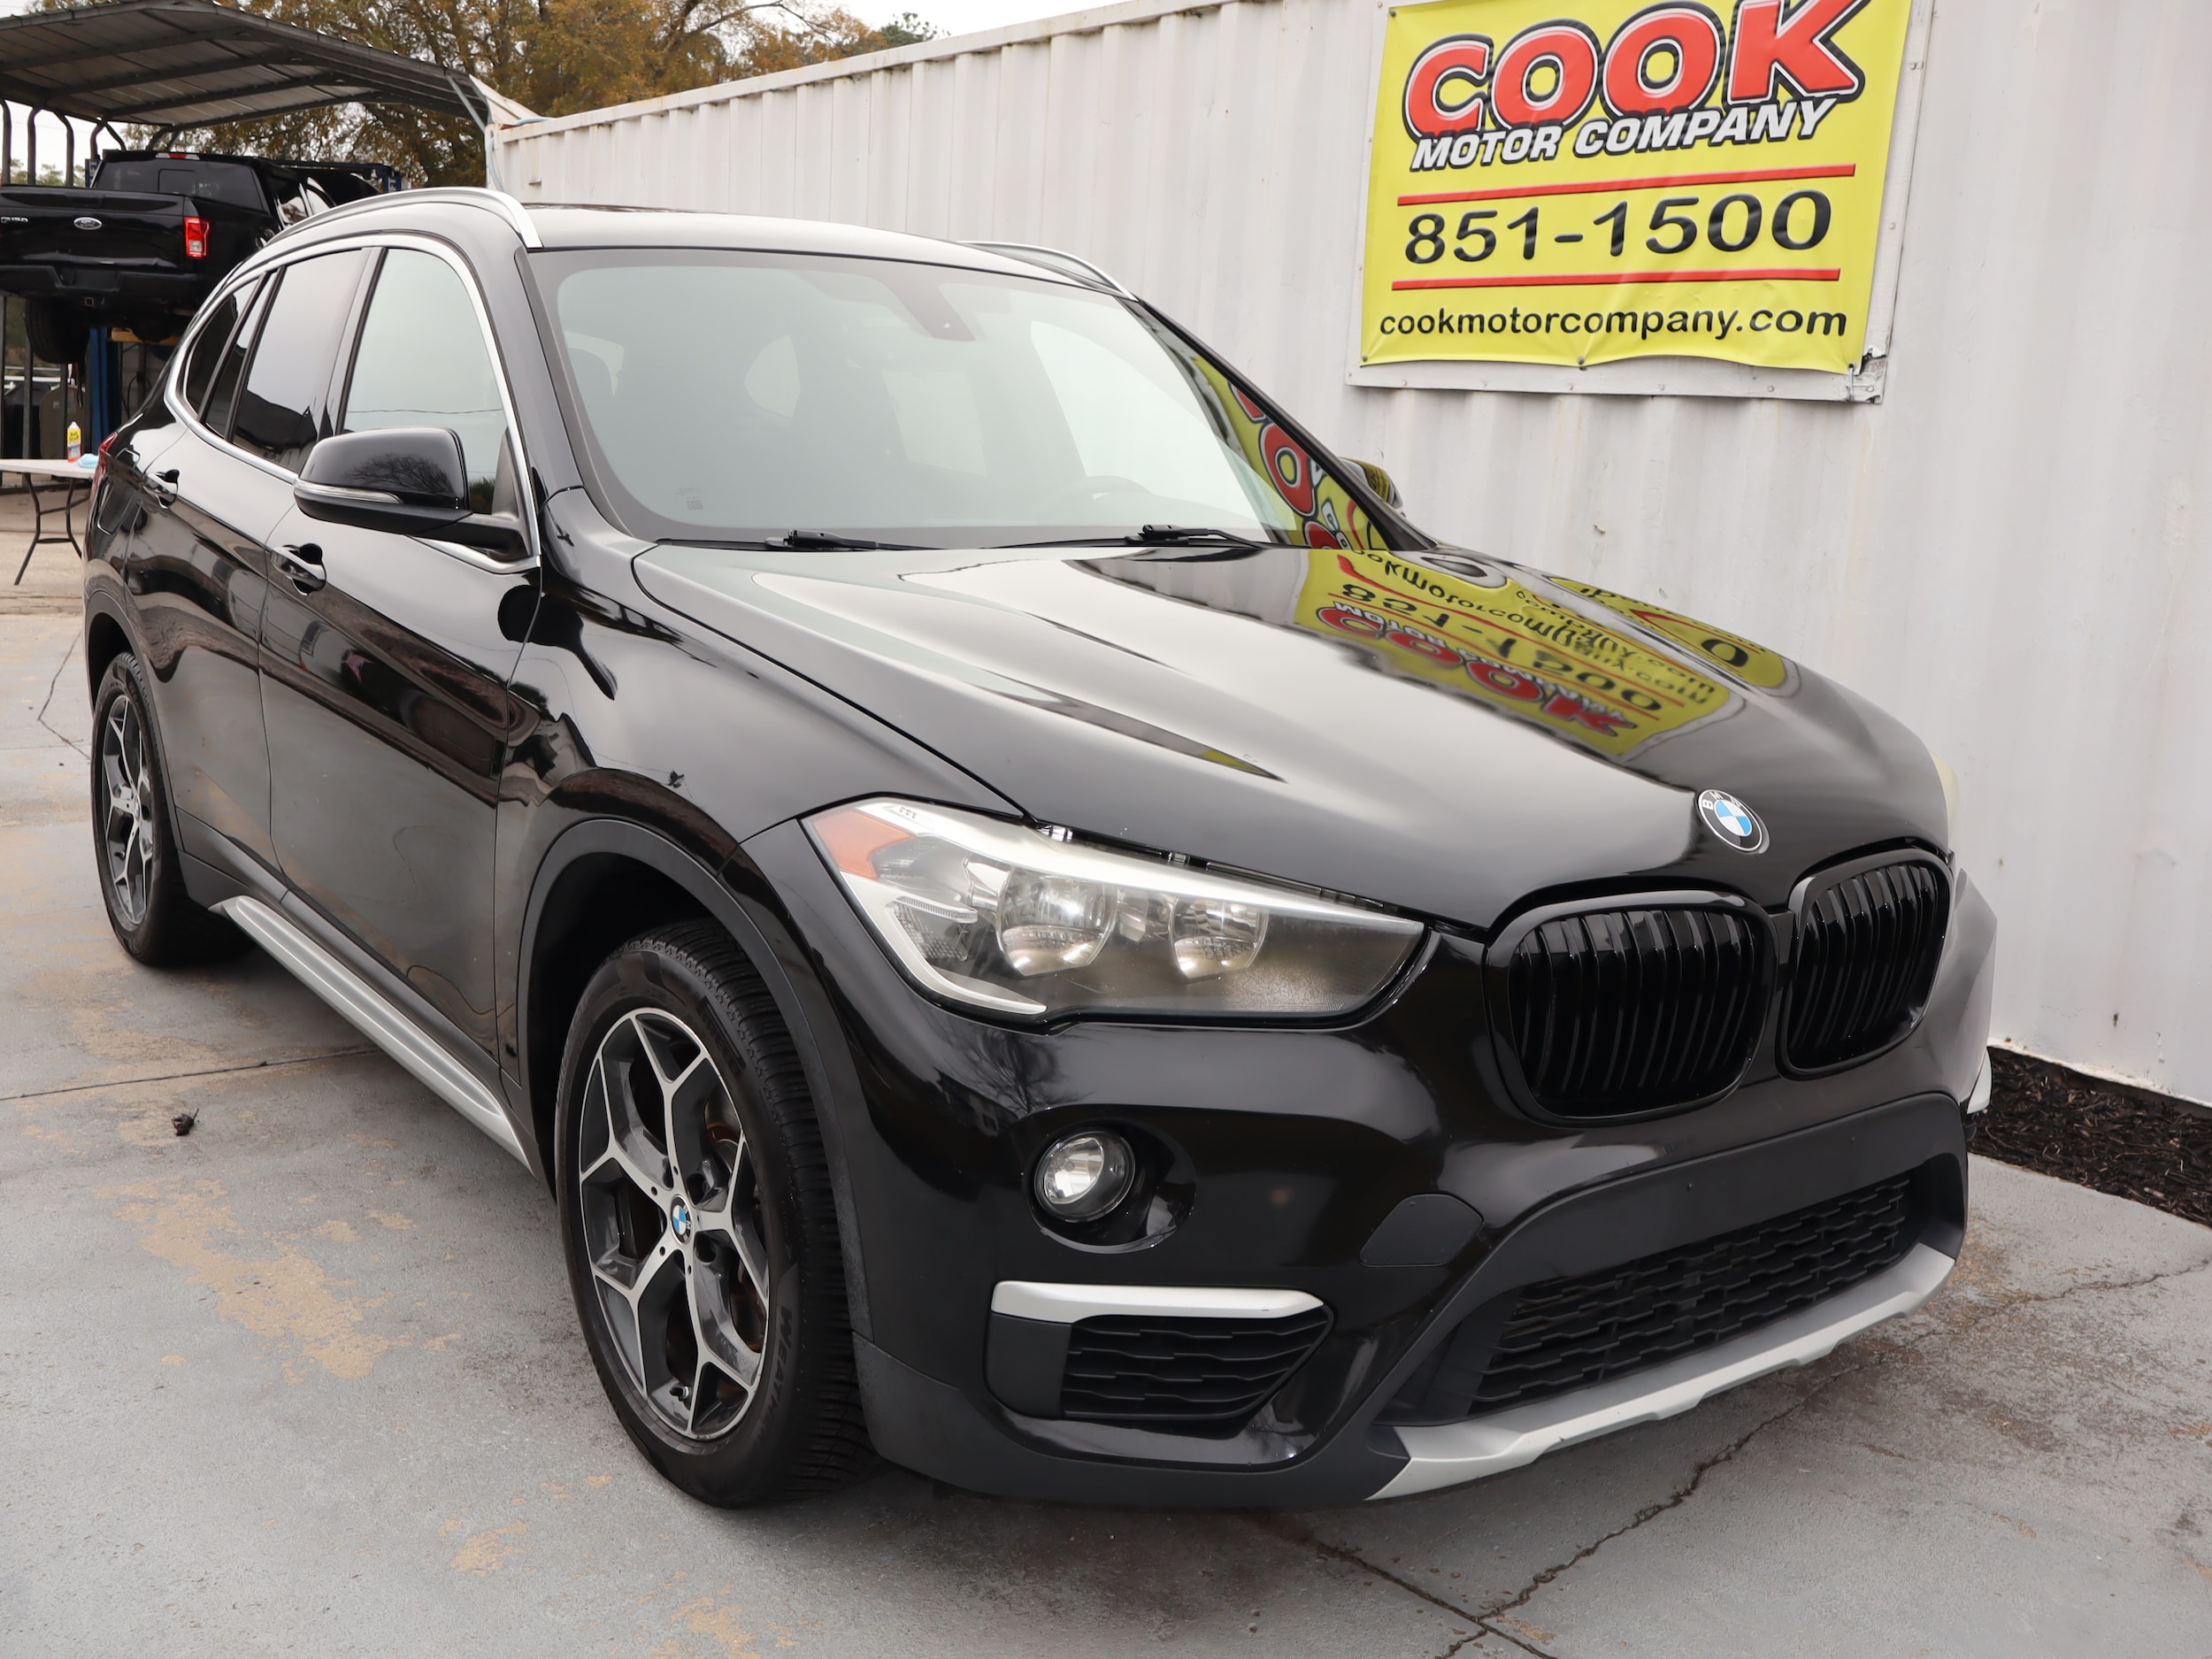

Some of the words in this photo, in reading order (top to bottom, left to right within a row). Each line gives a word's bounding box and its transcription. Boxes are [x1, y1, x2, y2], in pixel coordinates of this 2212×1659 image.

[1402, 0, 1866, 143] COOK
[1409, 124, 1563, 172] MOTOR
[1572, 96, 1838, 159] COMPANY
[1404, 189, 1832, 265] 851-1500
[1379, 305, 1847, 341] cookmotorcompany.com
